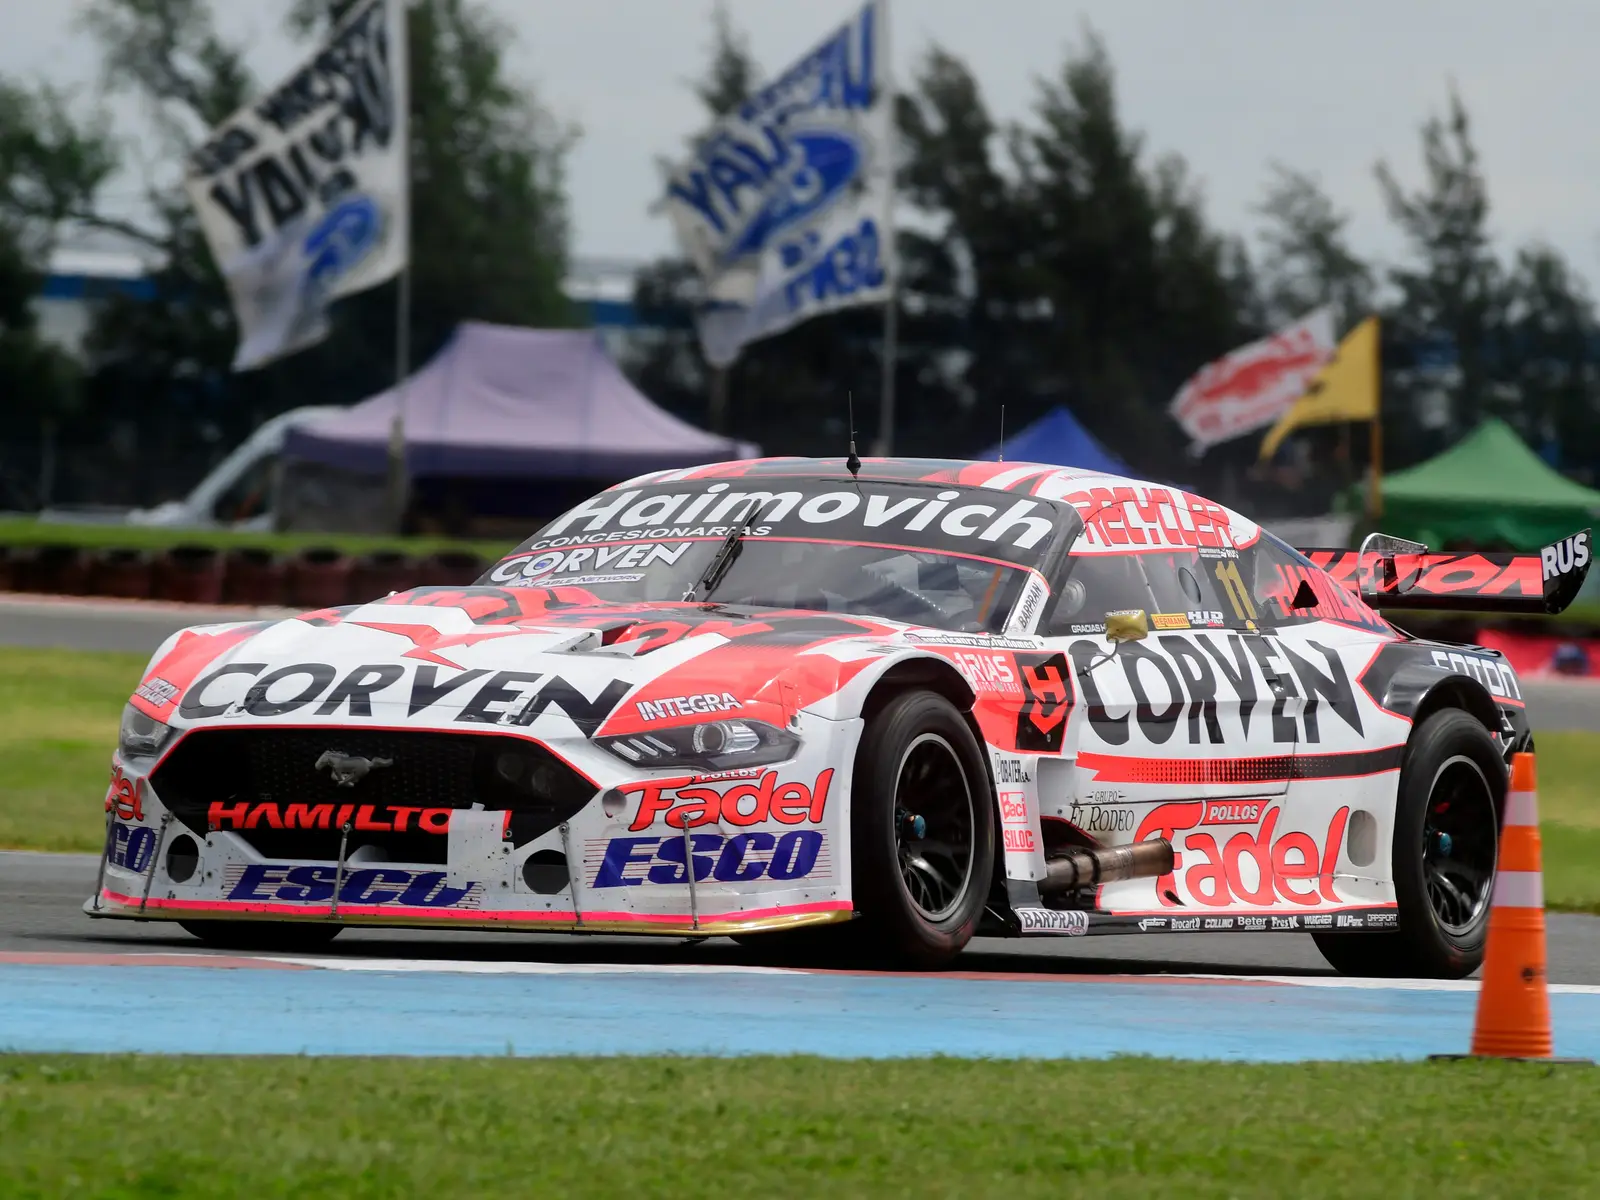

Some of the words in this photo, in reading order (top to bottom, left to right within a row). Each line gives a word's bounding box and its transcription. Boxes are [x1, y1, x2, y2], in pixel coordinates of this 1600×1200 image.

[543, 482, 1053, 549] Haimovich
[530, 526, 772, 550] CONCESIONARIAS
[1541, 533, 1589, 581] RUS
[490, 542, 694, 583] CORVEN
[577, 573, 638, 584] NETWORK
[1018, 582, 1042, 629] BARPRAN
[1215, 560, 1258, 620] 11
[1153, 615, 1189, 626] HERMANN
[179, 662, 632, 739] CORVEN
[635, 692, 743, 722] INTEGRA
[1069, 633, 1365, 746] CORVEN
[605, 767, 834, 832] Fadel
[1094, 790, 1119, 802] GRUPO
[1208, 804, 1259, 821] POLLOS
[207, 801, 512, 839] HAMILTO
[1087, 806, 1136, 832] RODEO
[1004, 830, 1035, 848] SILOC
[1133, 805, 1350, 907] Fadel
[592, 829, 824, 889] ESCO
[1021, 911, 1086, 929] BARPRAN
[1237, 916, 1267, 926] Beter
